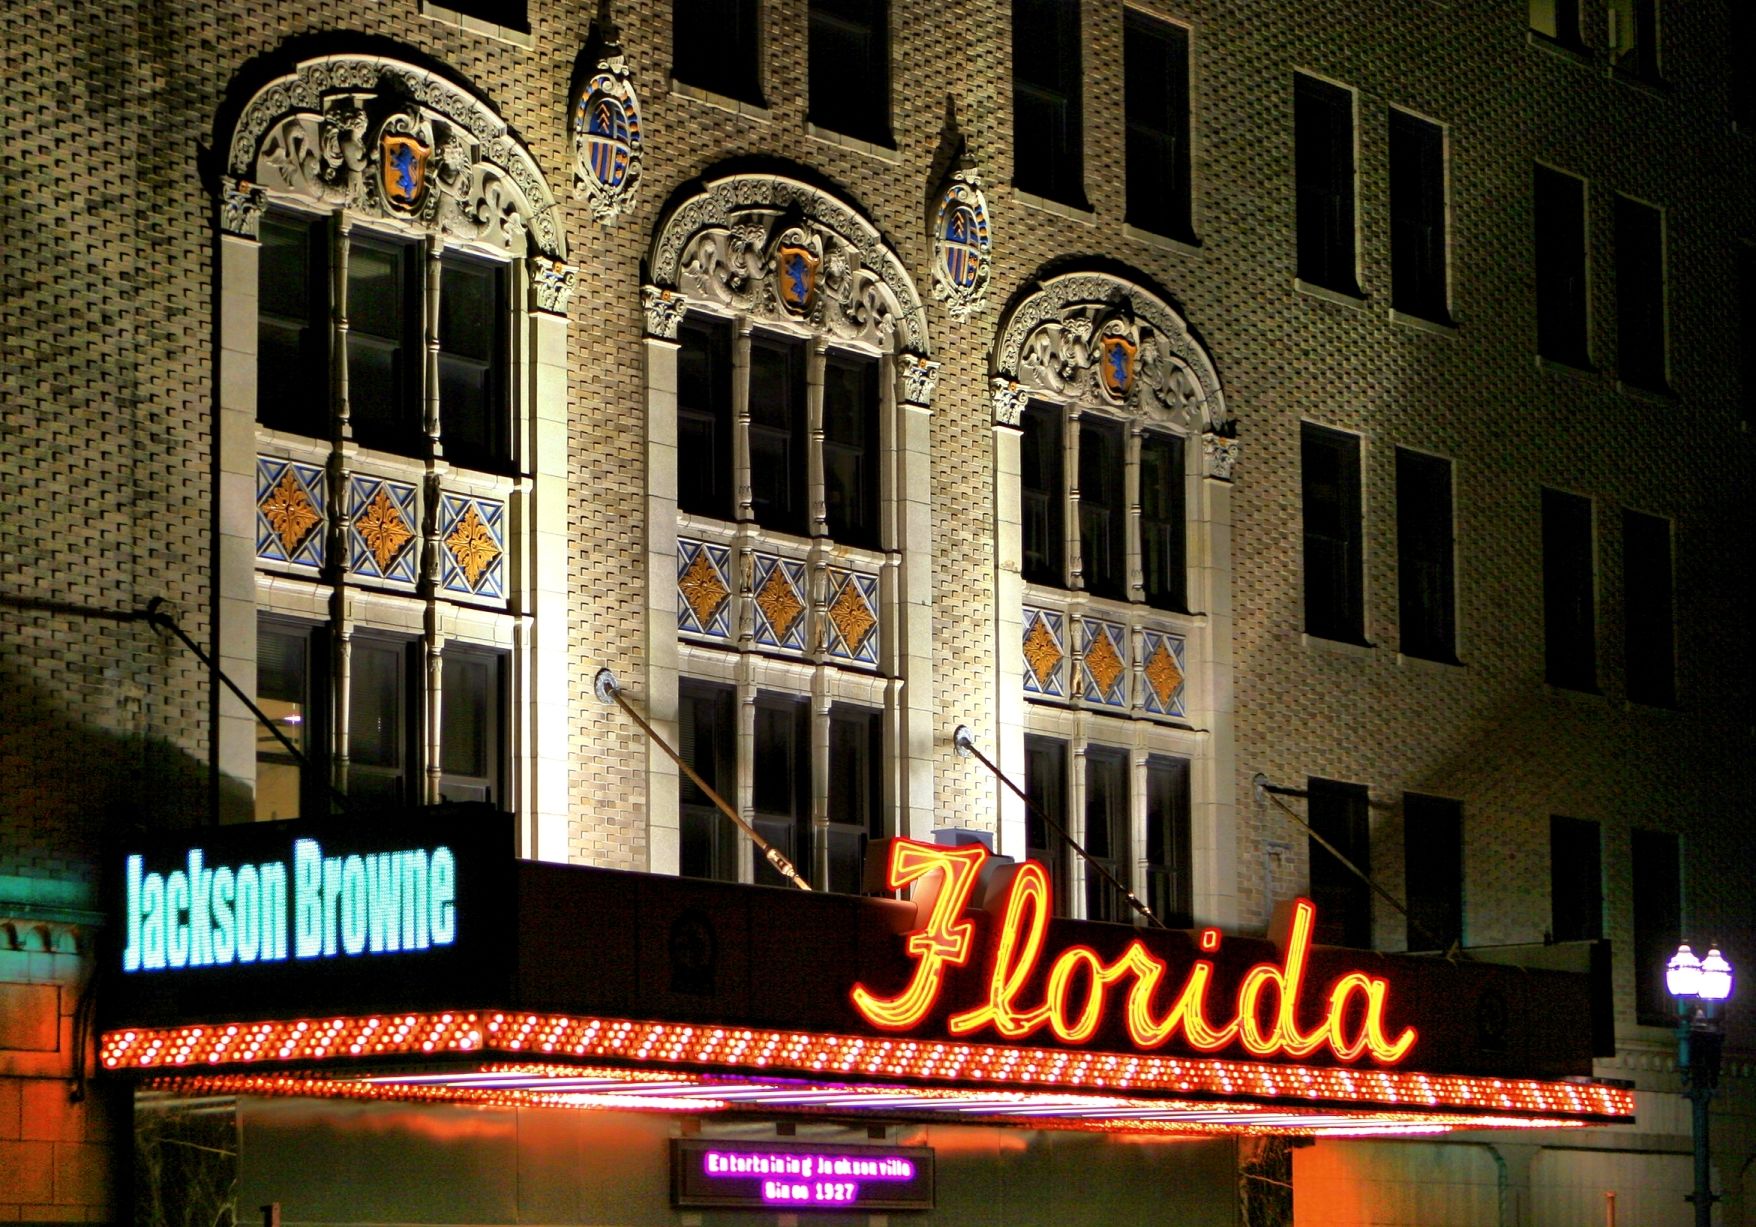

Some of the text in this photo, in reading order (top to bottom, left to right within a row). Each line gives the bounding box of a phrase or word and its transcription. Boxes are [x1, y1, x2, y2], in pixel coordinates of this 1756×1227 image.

[123, 838, 457, 972] Jackson Browne
[852, 836, 1418, 1062] Florida
[707, 1153, 913, 1178] Entertaining Jacksonville
[764, 1181, 856, 1201] Since 1927
